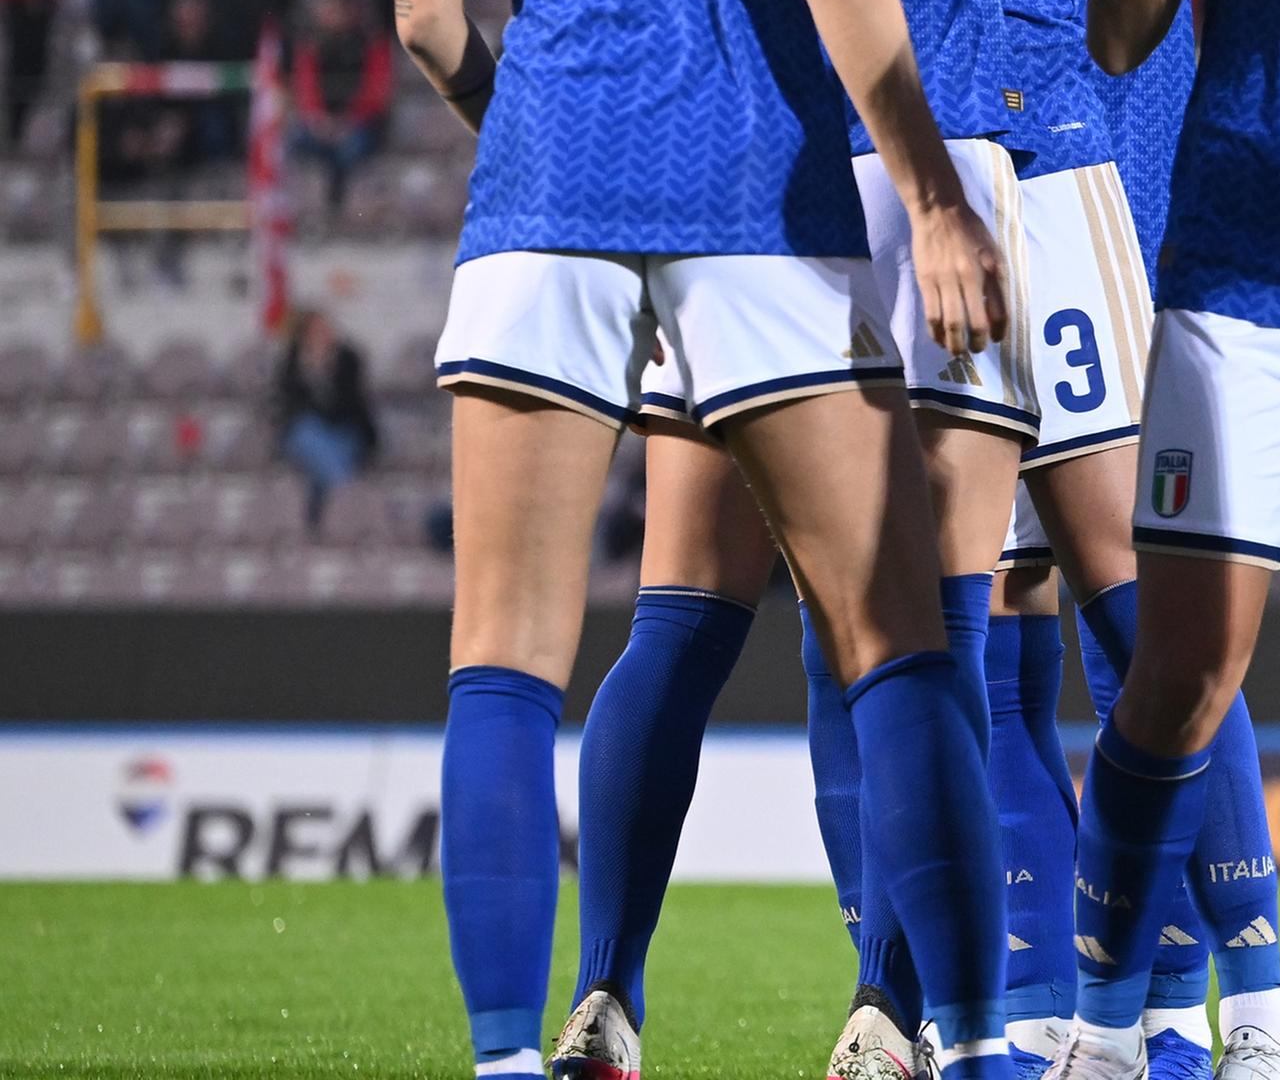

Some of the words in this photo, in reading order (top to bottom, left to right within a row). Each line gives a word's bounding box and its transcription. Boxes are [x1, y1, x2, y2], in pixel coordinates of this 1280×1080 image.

[1044, 308, 1108, 414] 3
[1208, 855, 1277, 883] ITALIA
[1074, 877, 1132, 908] ALIA
